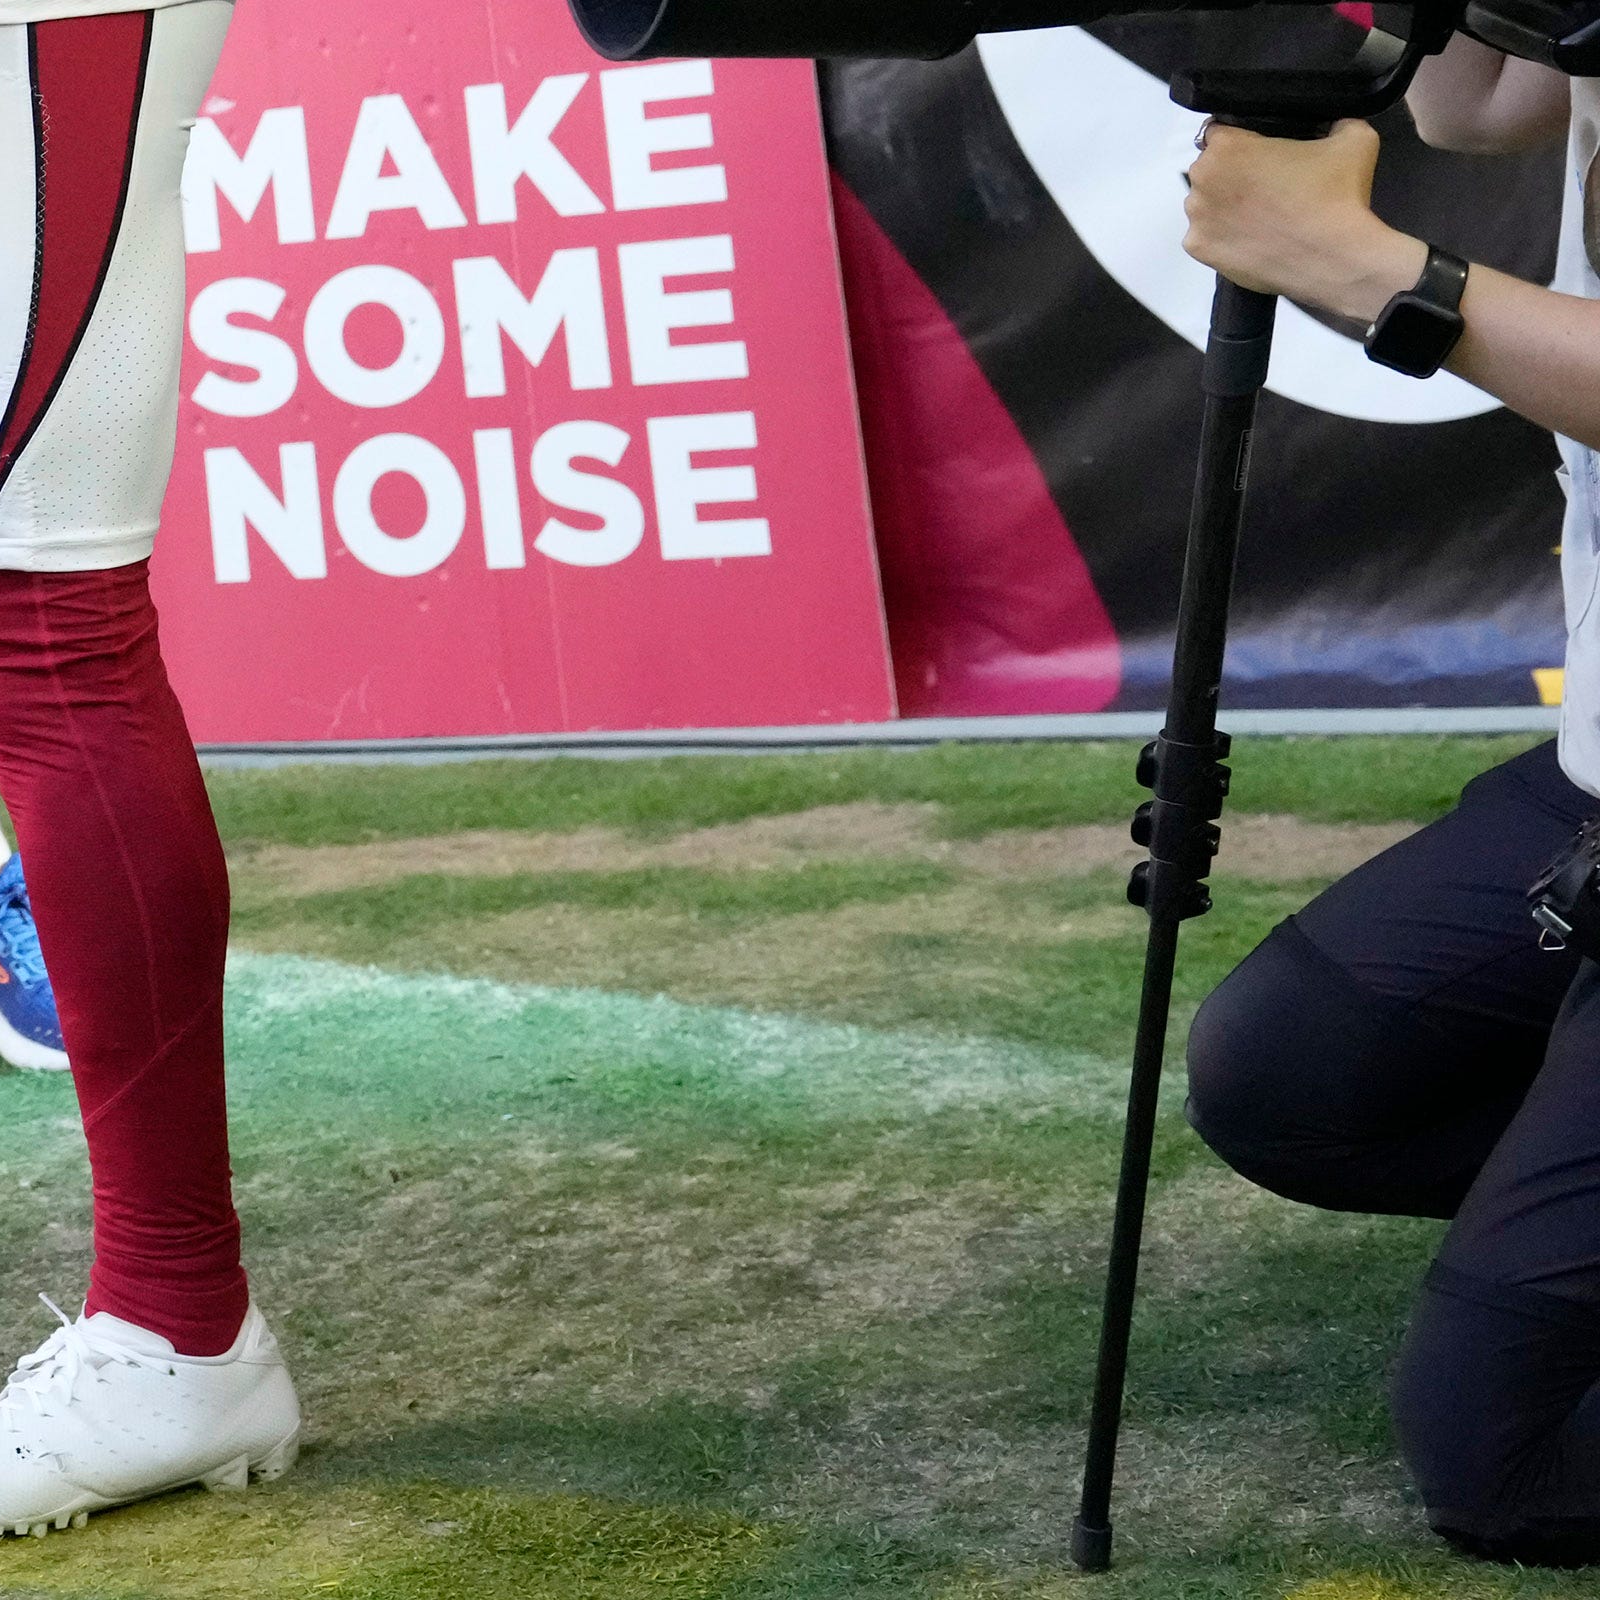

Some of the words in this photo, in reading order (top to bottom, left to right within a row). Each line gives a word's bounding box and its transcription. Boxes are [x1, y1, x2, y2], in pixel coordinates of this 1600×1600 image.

[181, 59, 728, 254] MAKE
[189, 233, 750, 418] SOME
[203, 411, 773, 585] NOISE
